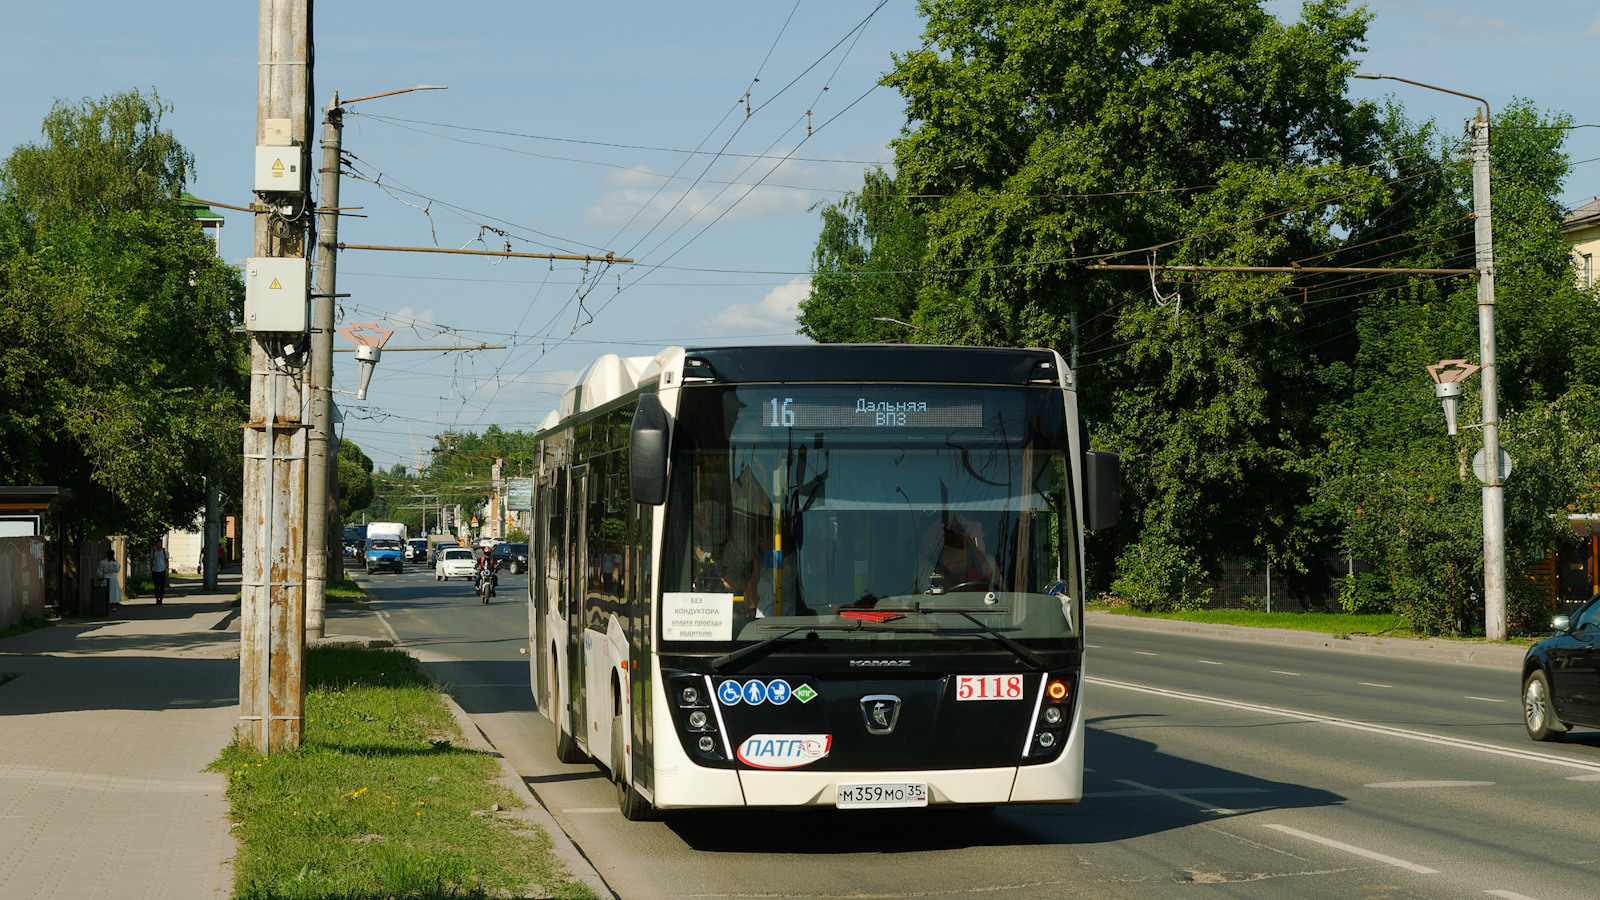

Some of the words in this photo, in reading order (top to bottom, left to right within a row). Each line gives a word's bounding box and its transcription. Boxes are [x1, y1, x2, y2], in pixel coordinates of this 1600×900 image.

[770, 397, 795, 427] 16
[855, 398, 927, 414] Дальняя
[875, 412, 907, 426] ВПЗ
[694, 619, 722, 627] проезда
[849, 659, 912, 667] KAMAZ
[959, 676, 1021, 699] 5118
[745, 739, 803, 757] ПАТП
[907, 785, 922, 796] 35
